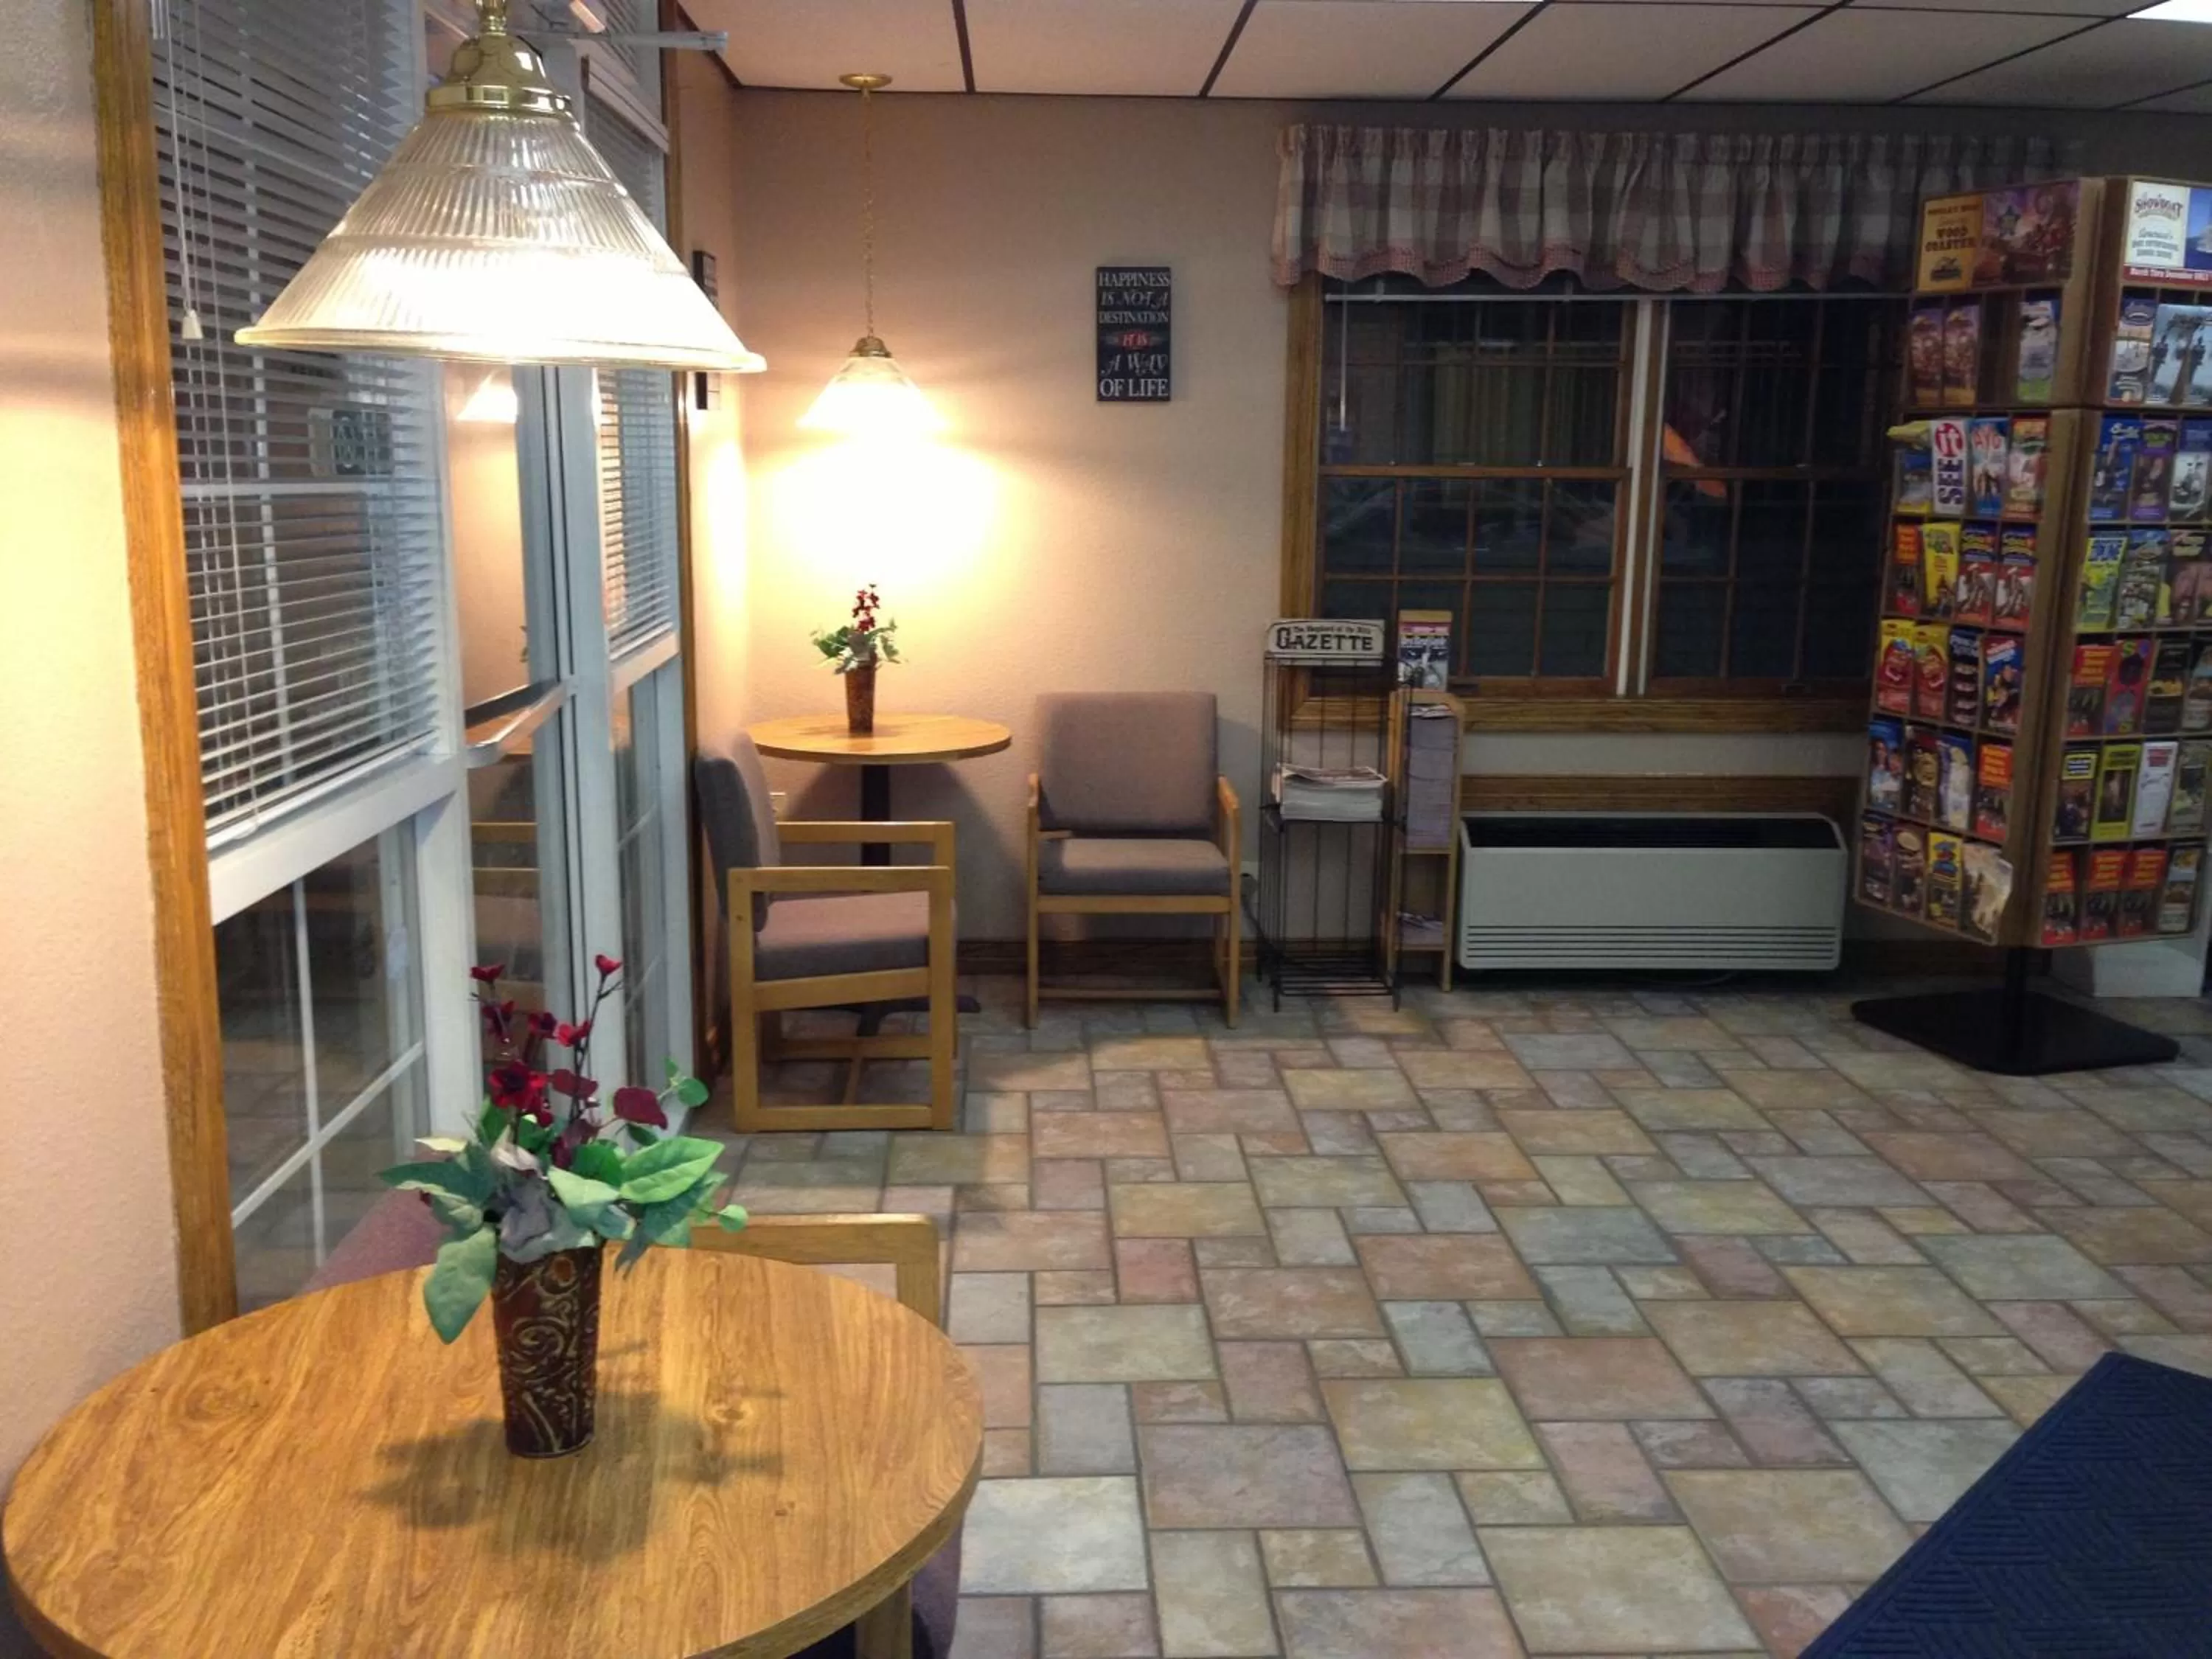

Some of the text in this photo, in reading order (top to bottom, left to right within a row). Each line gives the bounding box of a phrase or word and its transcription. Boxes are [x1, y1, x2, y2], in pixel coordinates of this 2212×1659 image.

[1099, 272, 1169, 286] HAPPINESS
[1099, 310, 1168, 324] DESTINATION
[1127, 352, 1168, 376] WAY
[1100, 378, 1168, 397] OF LIFE
[1276, 627, 1373, 650] GAZETTE
